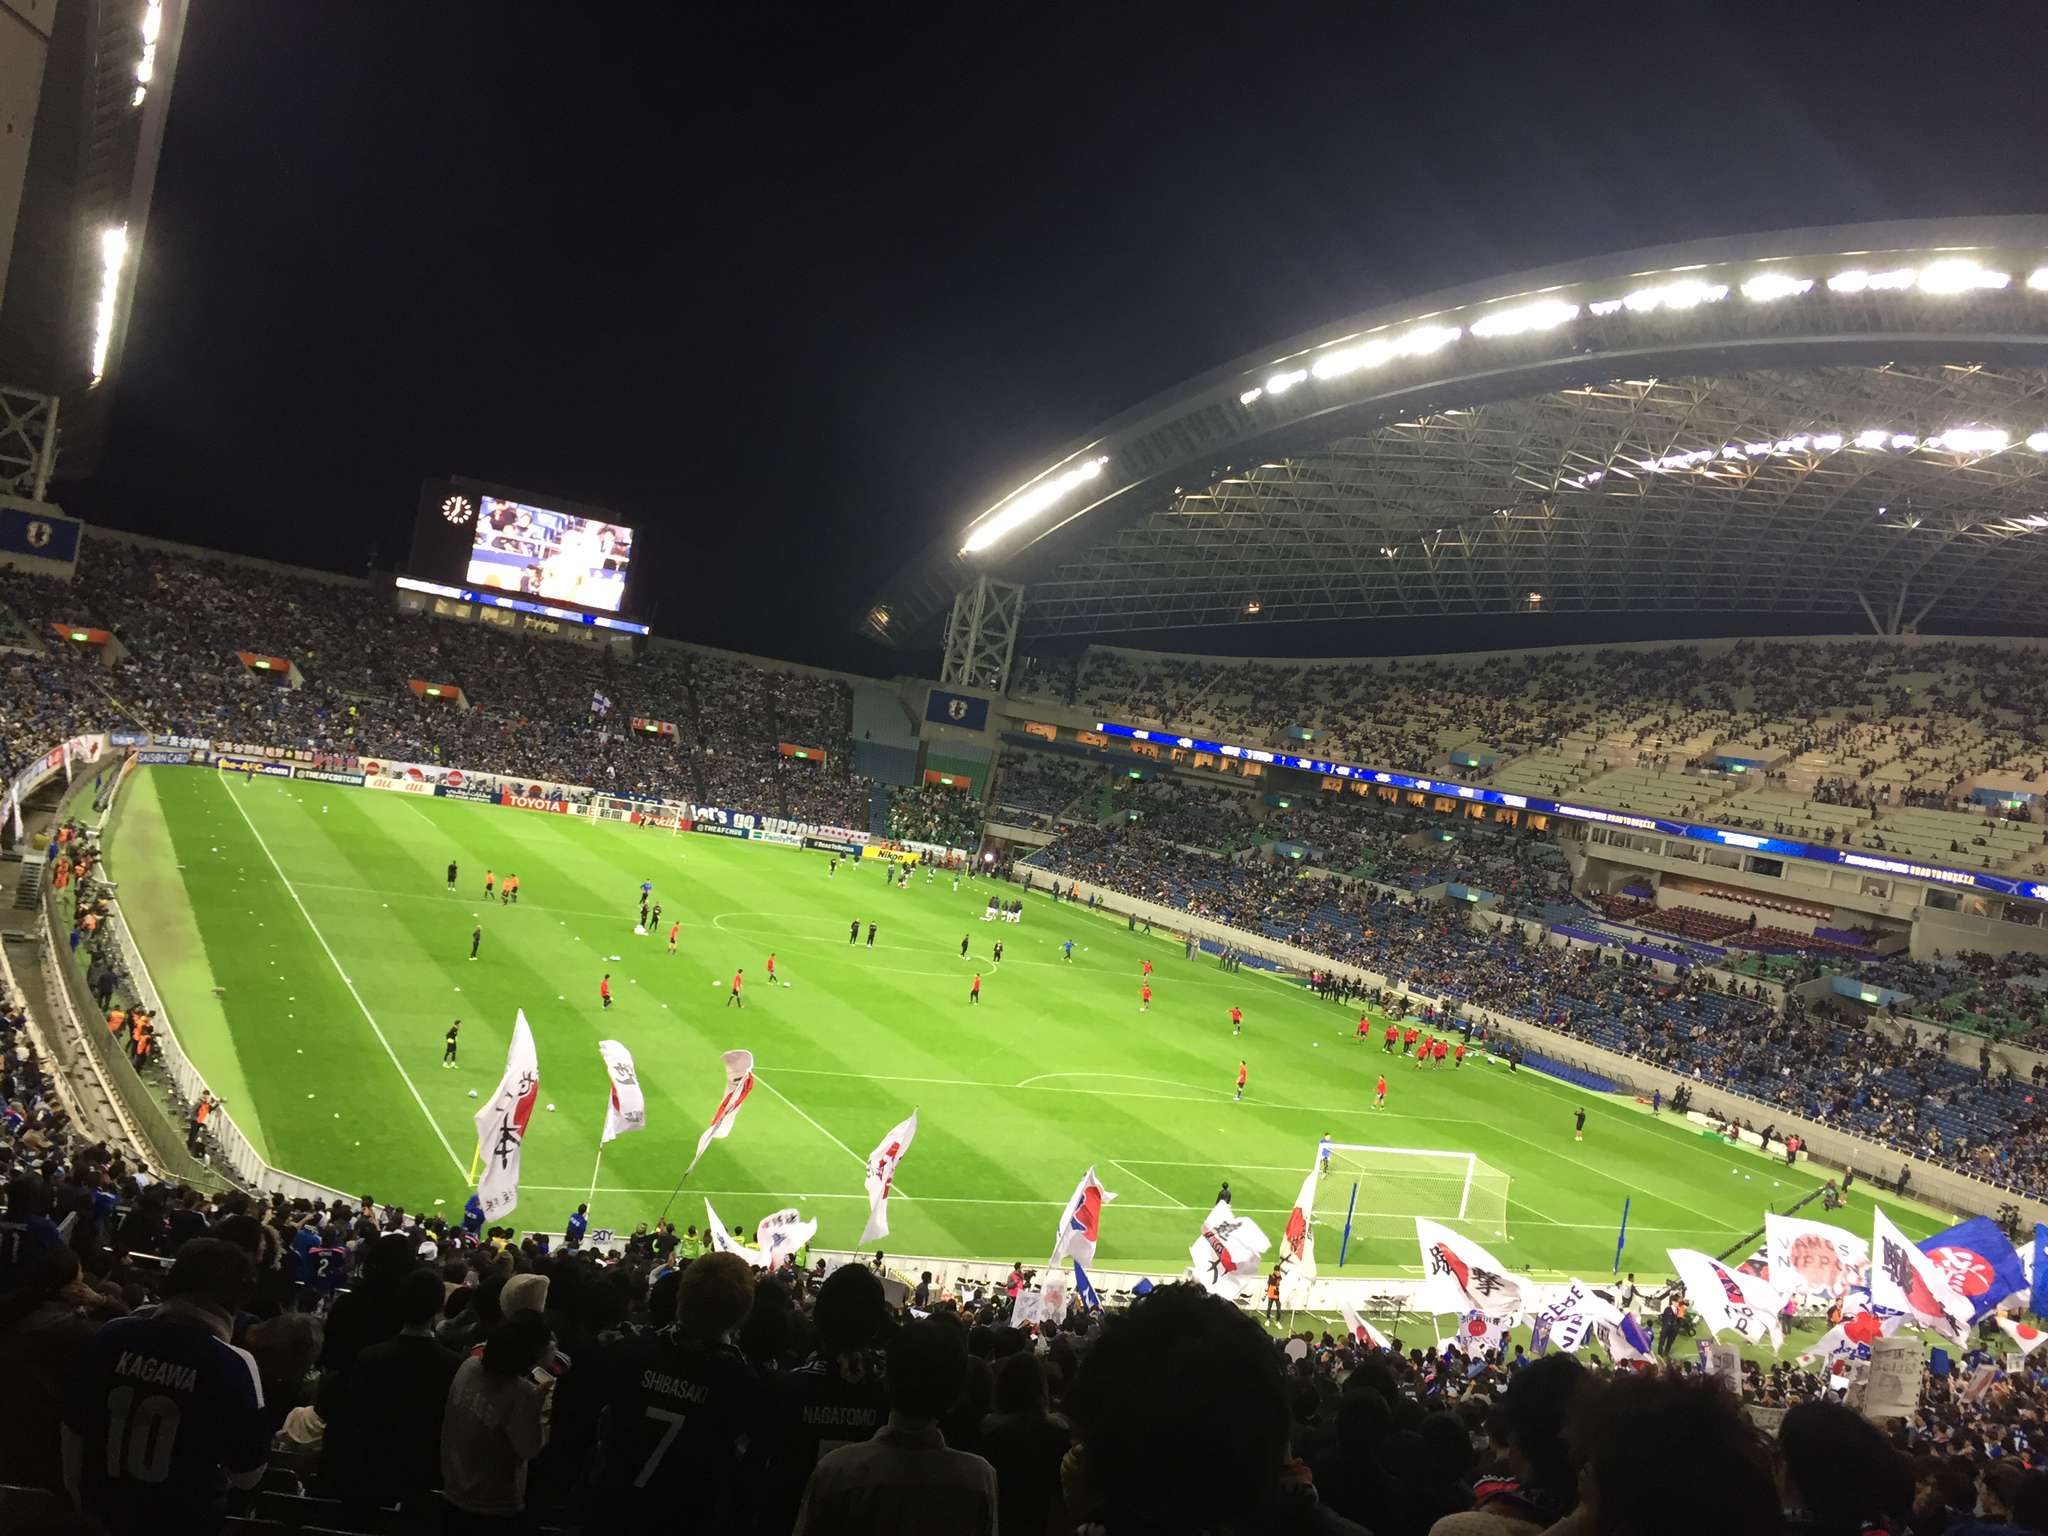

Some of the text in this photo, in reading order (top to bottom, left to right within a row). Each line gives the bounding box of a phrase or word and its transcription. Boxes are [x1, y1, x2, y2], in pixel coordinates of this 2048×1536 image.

[138, 753, 189, 763] SAISON CARD
[373, 779, 393, 788] au
[406, 782, 425, 792] au
[510, 796, 560, 811] TOYOTA
[690, 804, 819, 836] Let's go NIPPON
[878, 850, 904, 861] Nikon
[1778, 1236, 1850, 1257] VAMOS
[317, 1258, 329, 1277] 2
[115, 1351, 197, 1393] KAGAWA
[641, 1369, 709, 1404] SHIBASAKI
[803, 1406, 877, 1426] NAGATOMO
[106, 1385, 181, 1482] 10
[633, 1406, 686, 1488] 7
